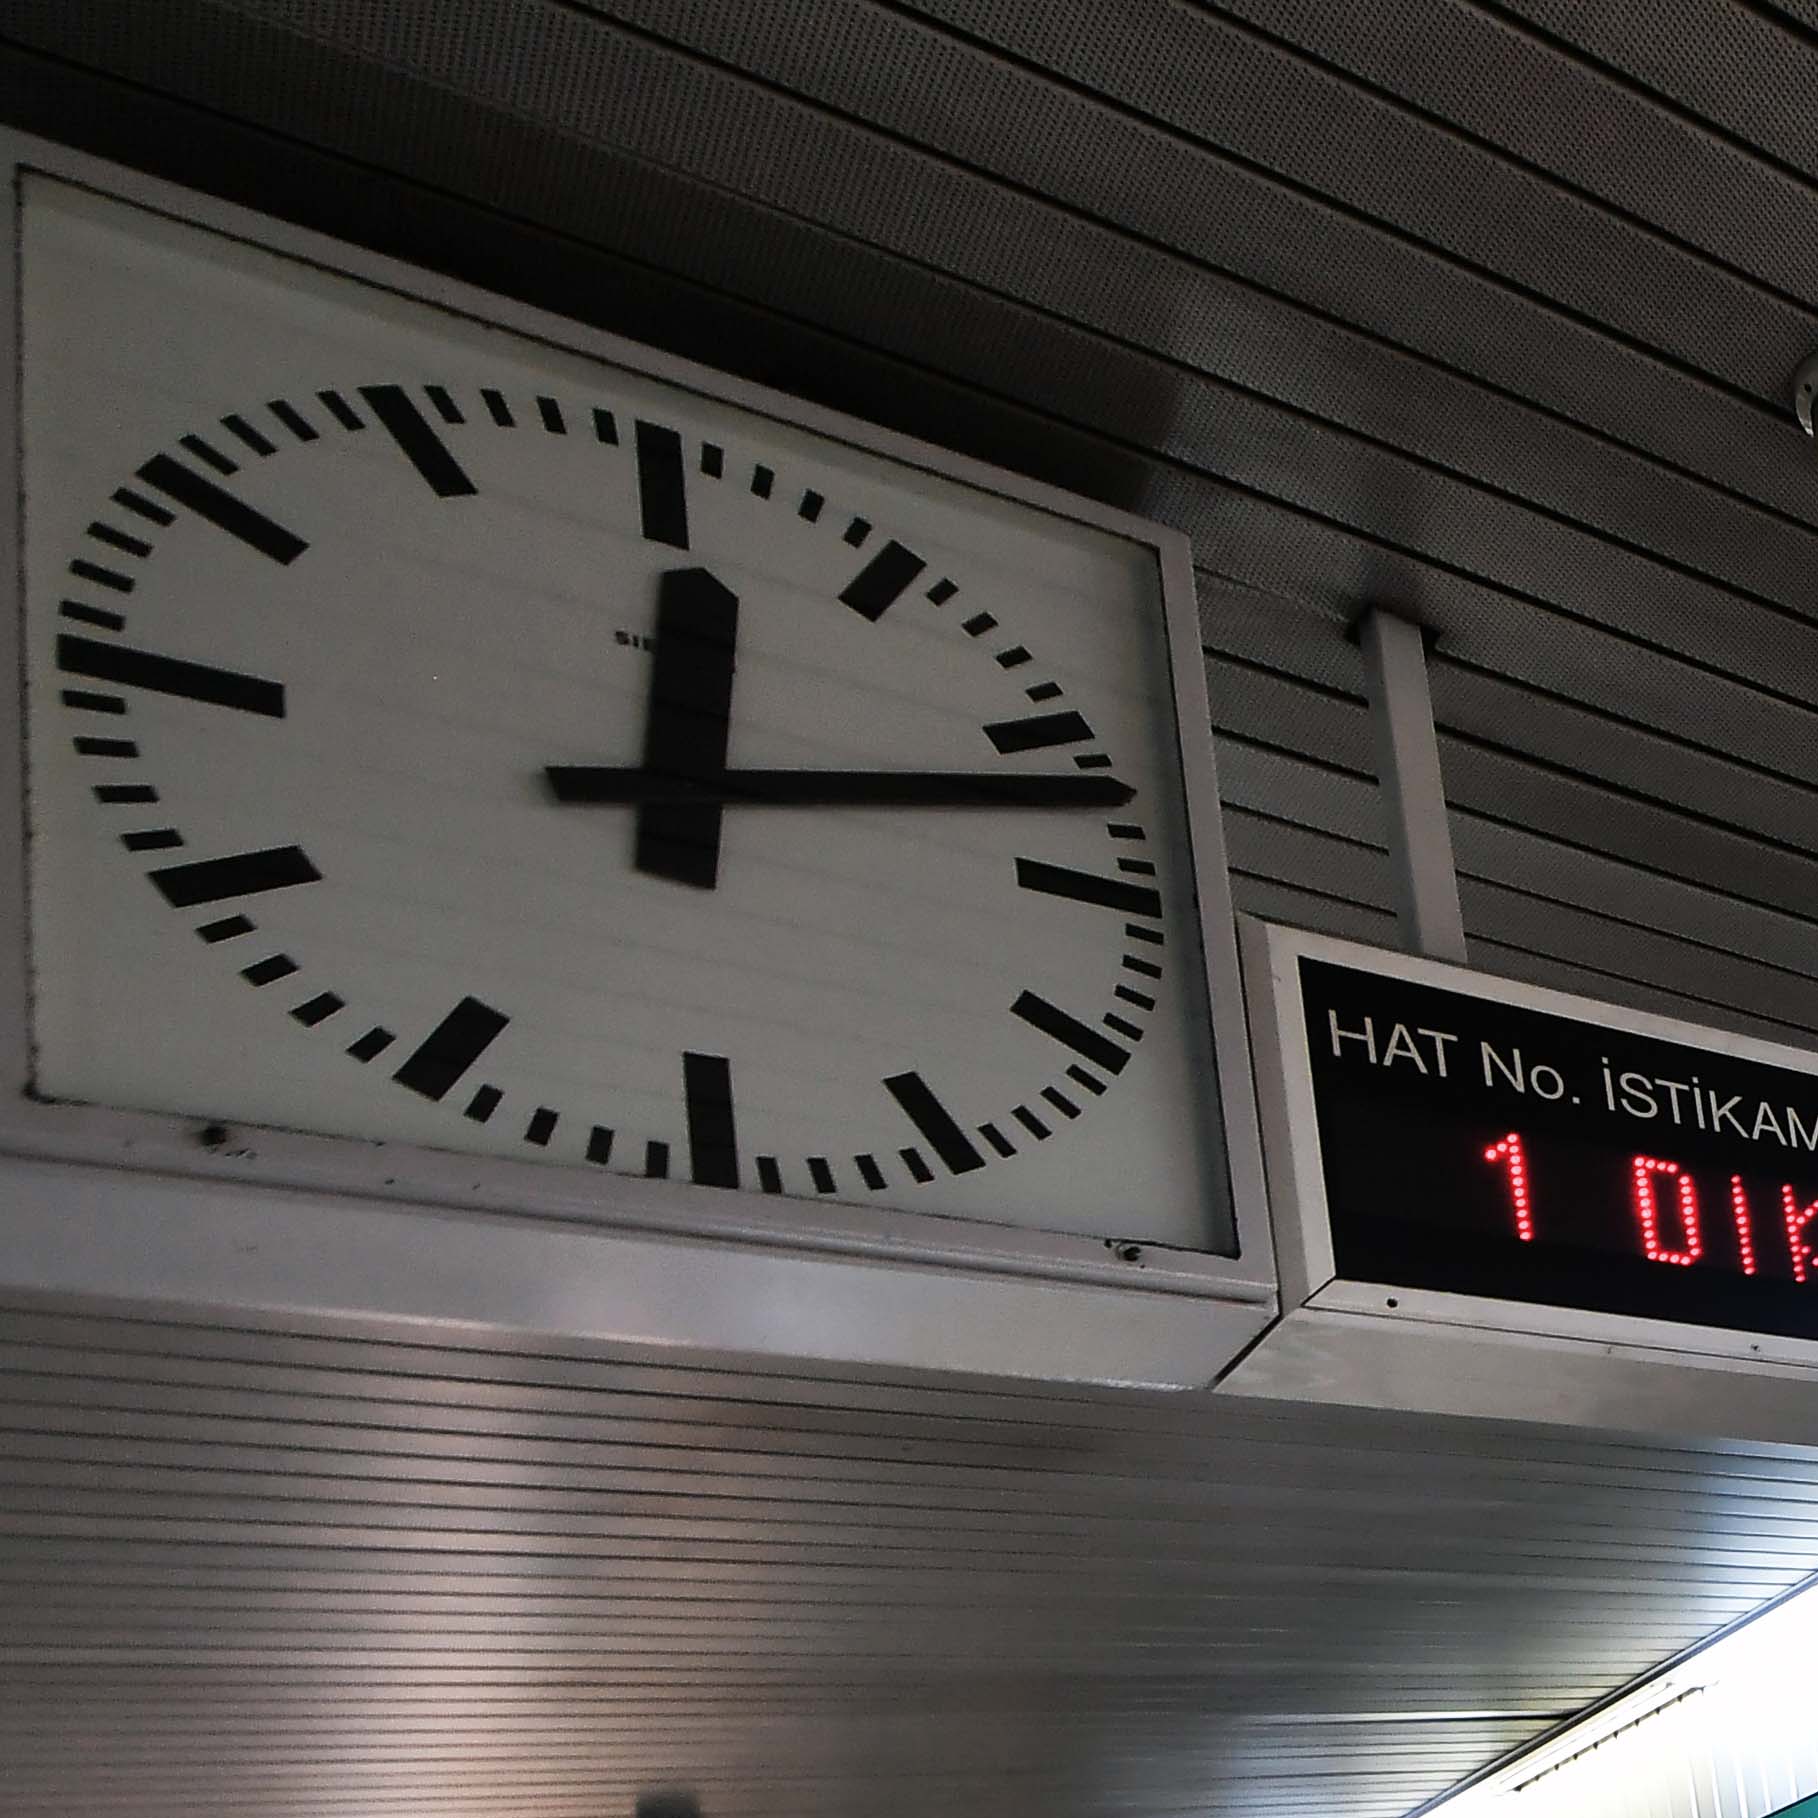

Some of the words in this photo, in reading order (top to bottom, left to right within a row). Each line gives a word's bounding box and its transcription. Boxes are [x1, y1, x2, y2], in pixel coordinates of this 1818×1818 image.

[1328, 1008, 1459, 1078] HAT
[1480, 1041, 1580, 1104] No.
[1484, 1132, 1532, 1241] 1
